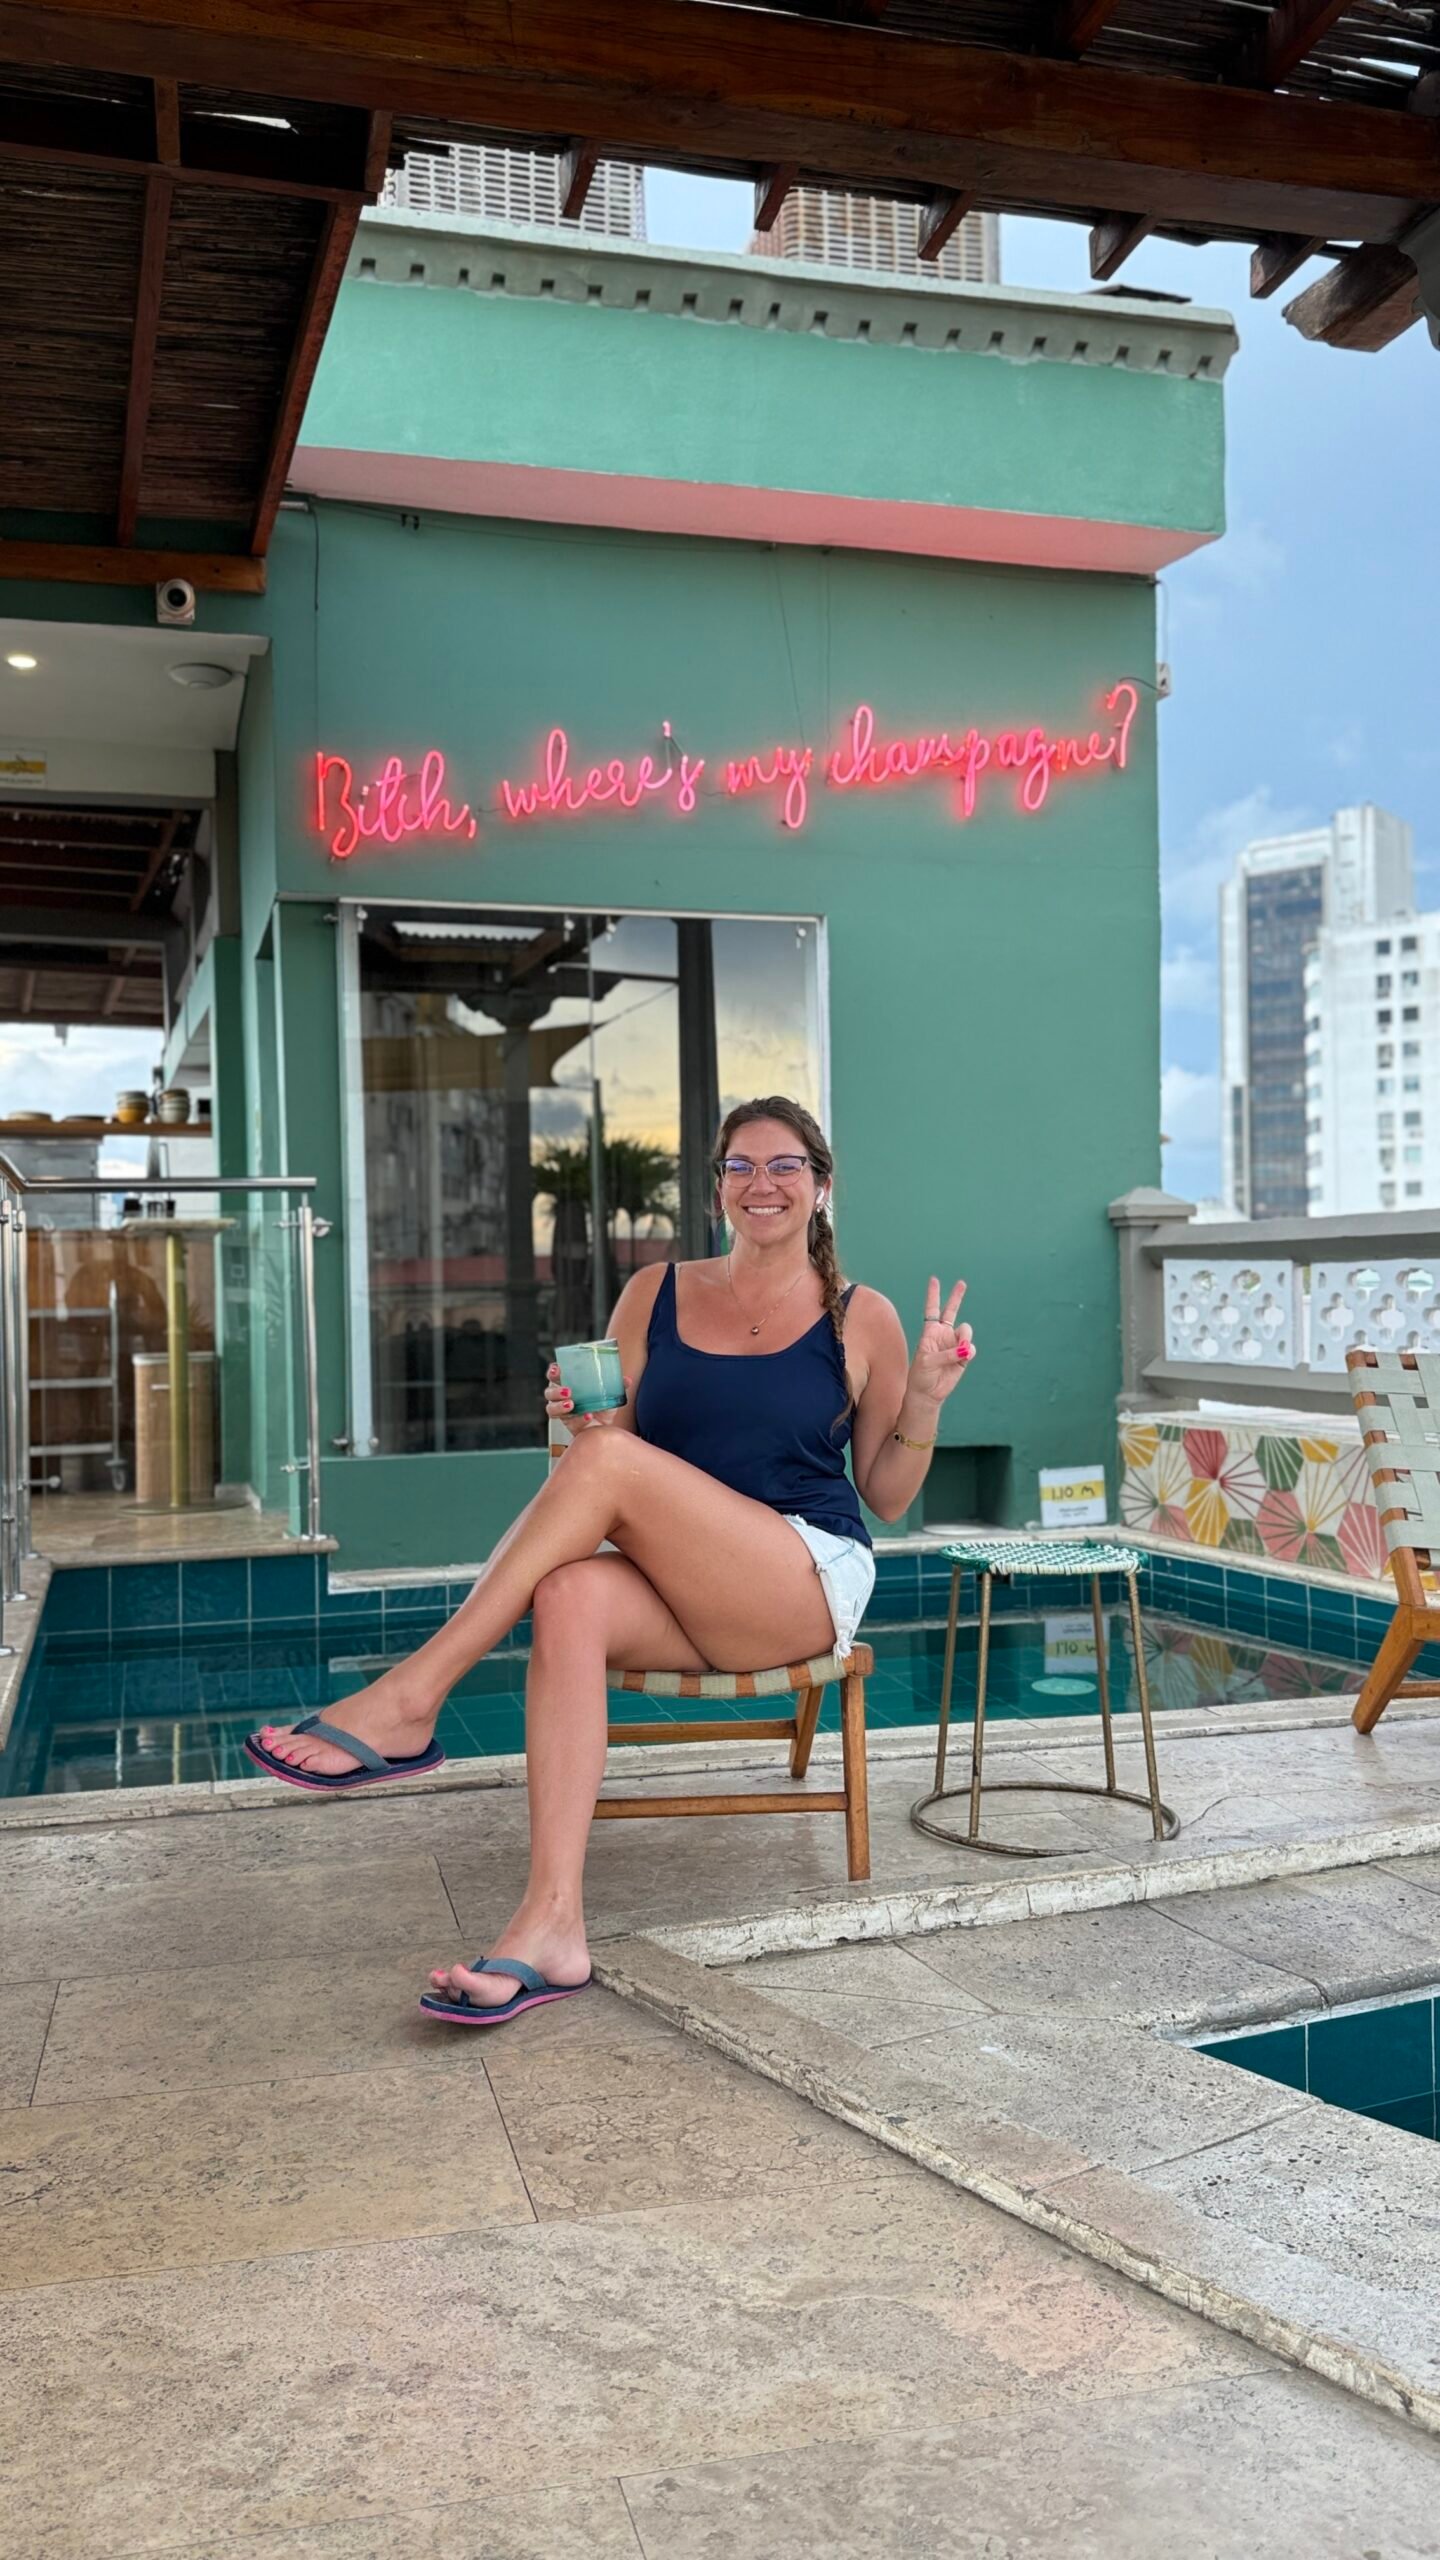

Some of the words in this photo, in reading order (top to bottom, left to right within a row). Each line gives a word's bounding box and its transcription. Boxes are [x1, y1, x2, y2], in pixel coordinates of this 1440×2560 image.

[316, 750, 477, 858] Bitch,
[502, 720, 705, 818] where's
[727, 746, 813, 829] my
[831, 683, 1138, 817] champagne?
